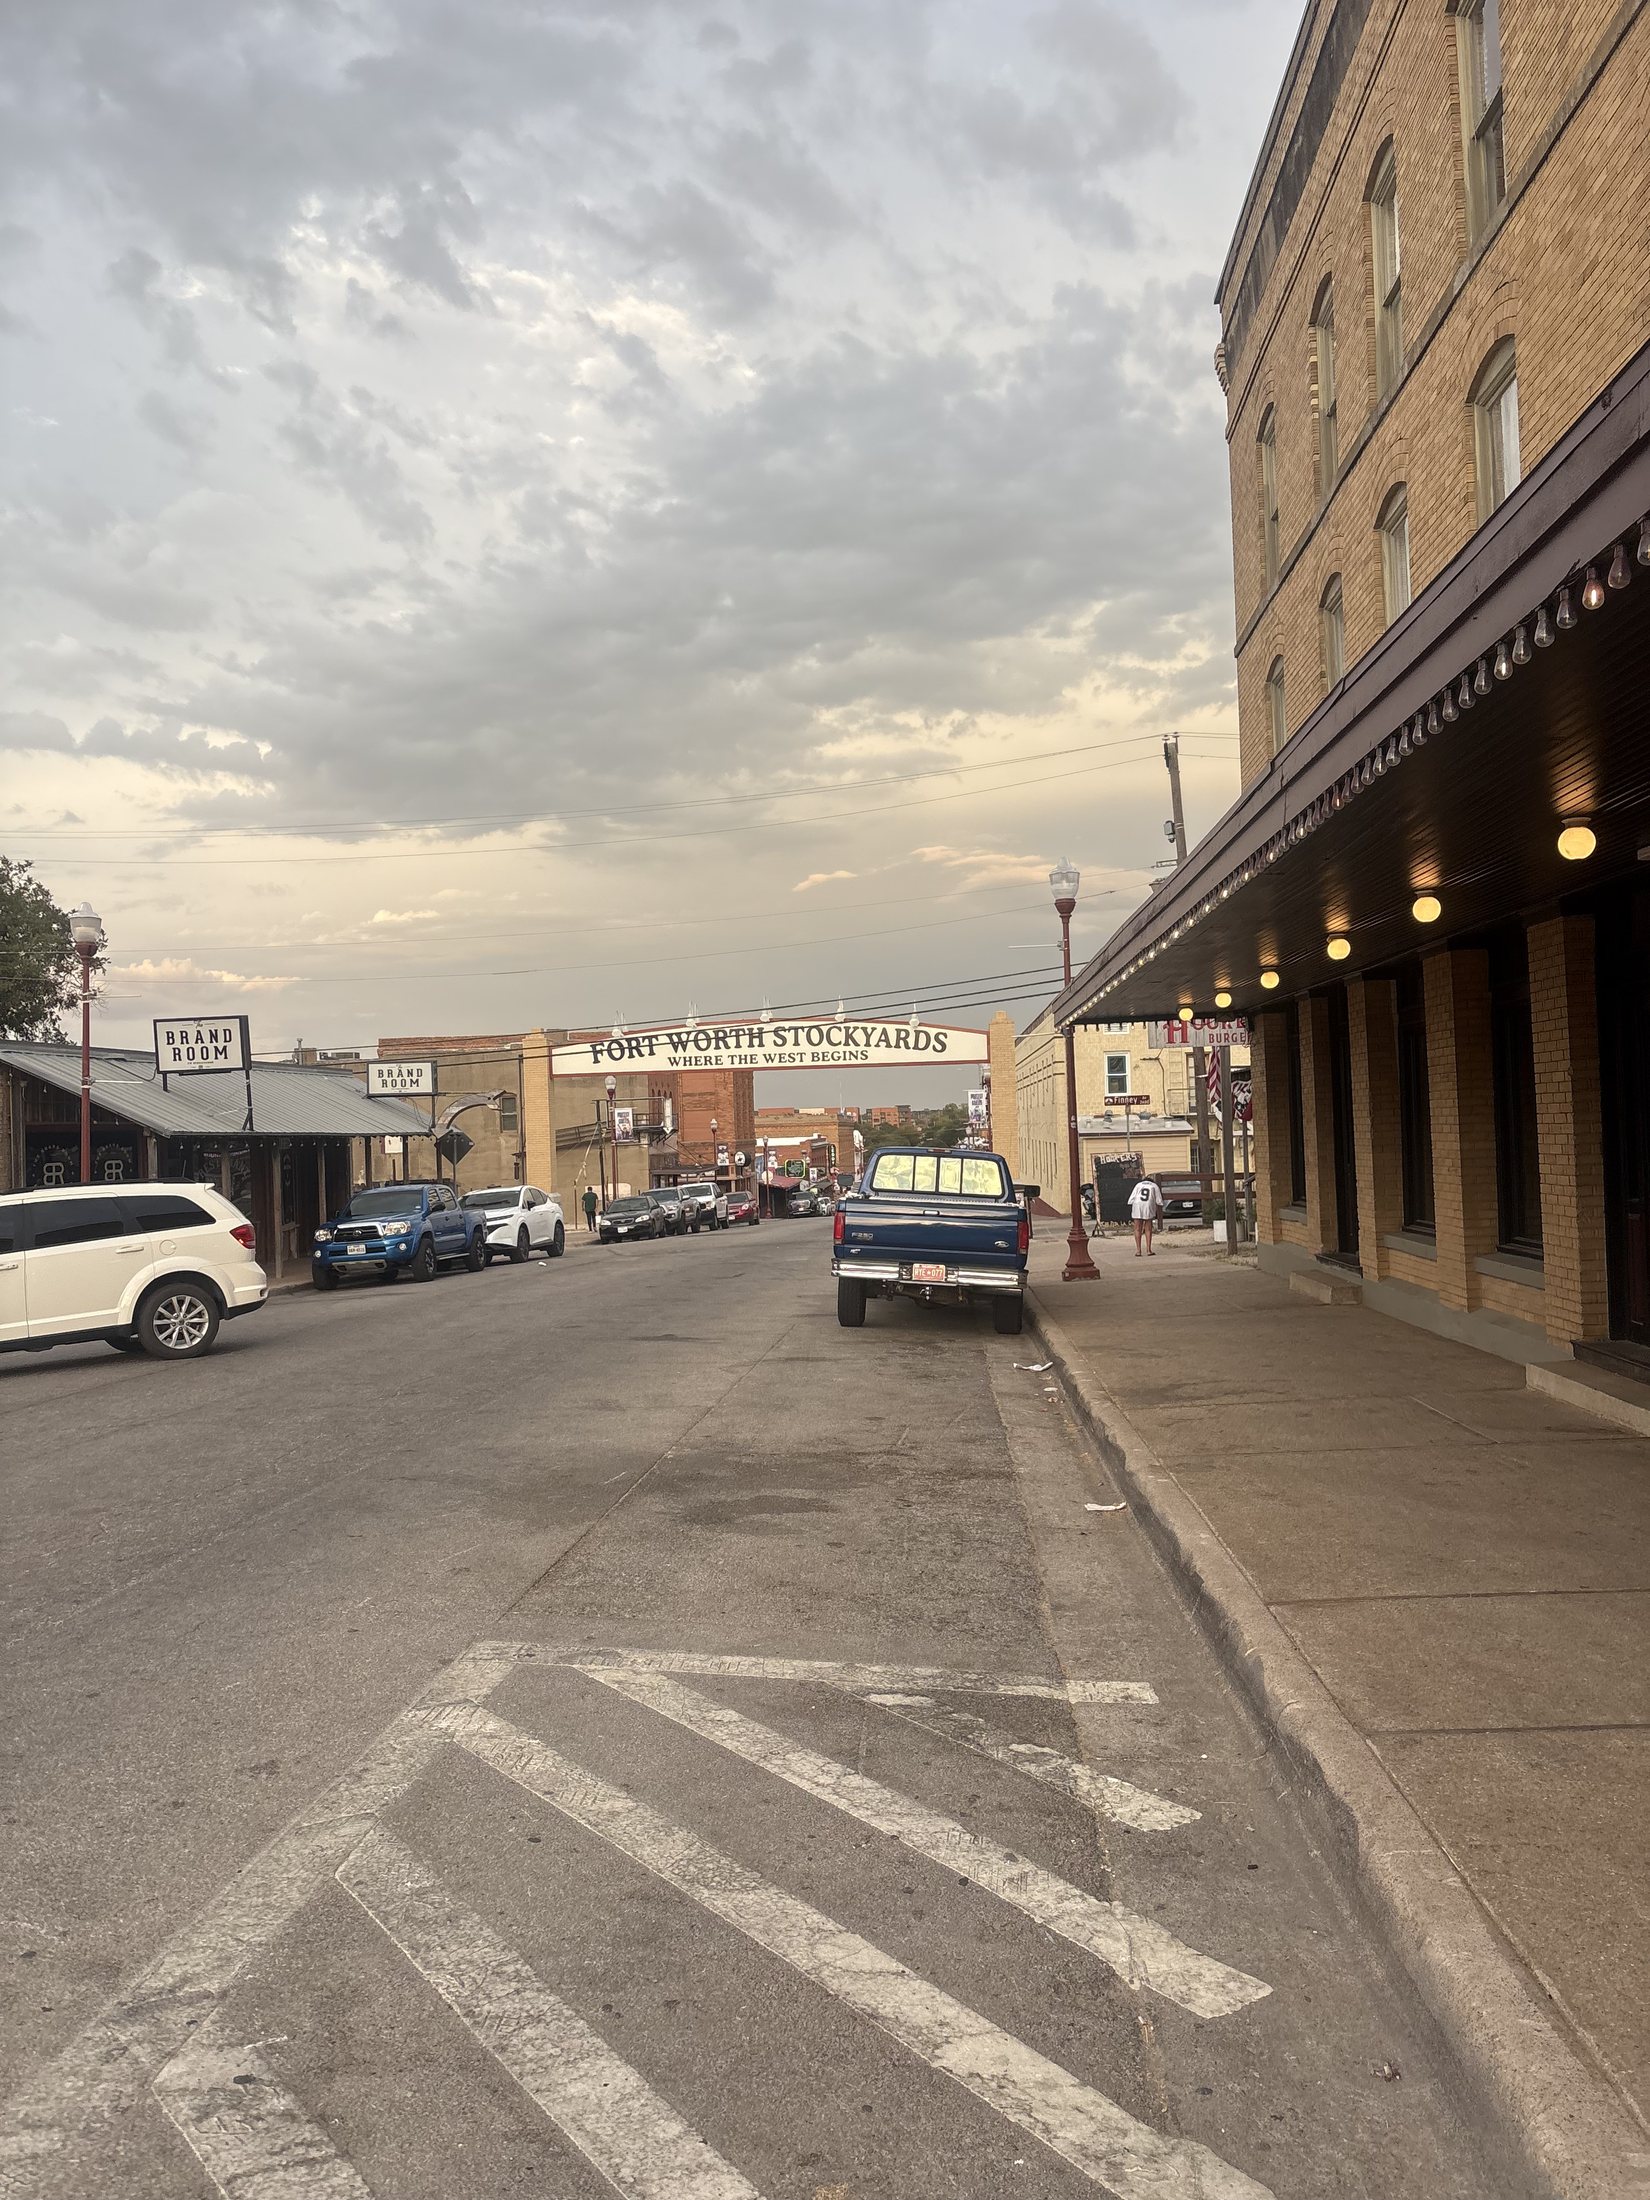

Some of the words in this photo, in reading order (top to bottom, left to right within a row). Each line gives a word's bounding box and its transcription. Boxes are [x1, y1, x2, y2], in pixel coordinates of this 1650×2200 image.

[166, 1029, 232, 1045] BRAND
[590, 1036, 658, 1064] FORT
[665, 1027, 765, 1053] WORTH
[773, 1026, 948, 1053] STOCKYARDS
[172, 1045, 228, 1061] ROOM
[668, 1055, 723, 1066] WHERE
[728, 1054, 758, 1065] THE
[763, 1052, 806, 1063] WEST
[811, 1050, 869, 1062] BEGINS
[378, 1069, 423, 1078] BRAND
[381, 1079, 420, 1088] ROOM
[1140, 1188, 1150, 1201] 9
